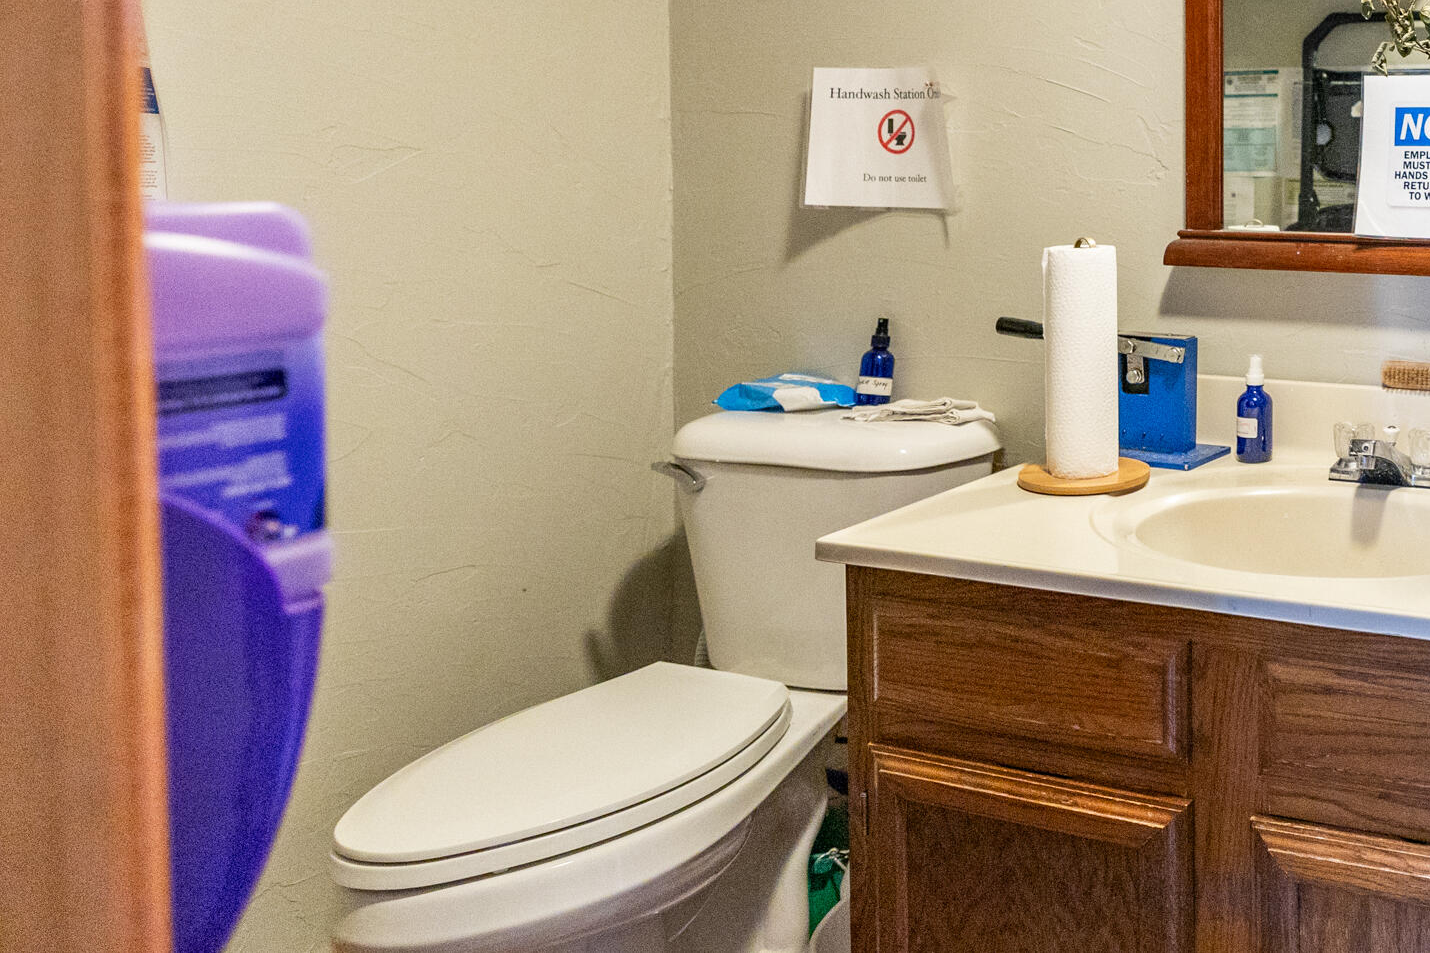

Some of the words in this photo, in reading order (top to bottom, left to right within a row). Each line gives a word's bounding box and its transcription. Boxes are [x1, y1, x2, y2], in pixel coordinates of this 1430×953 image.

[829, 87, 891, 100] Handwash
[893, 88, 926, 100] Station
[1403, 161, 1430, 170] MUST
[863, 173, 876, 182] Do
[908, 174, 927, 183] toilet
[1394, 171, 1428, 180] HANDS
[1409, 192, 1421, 200] TO
